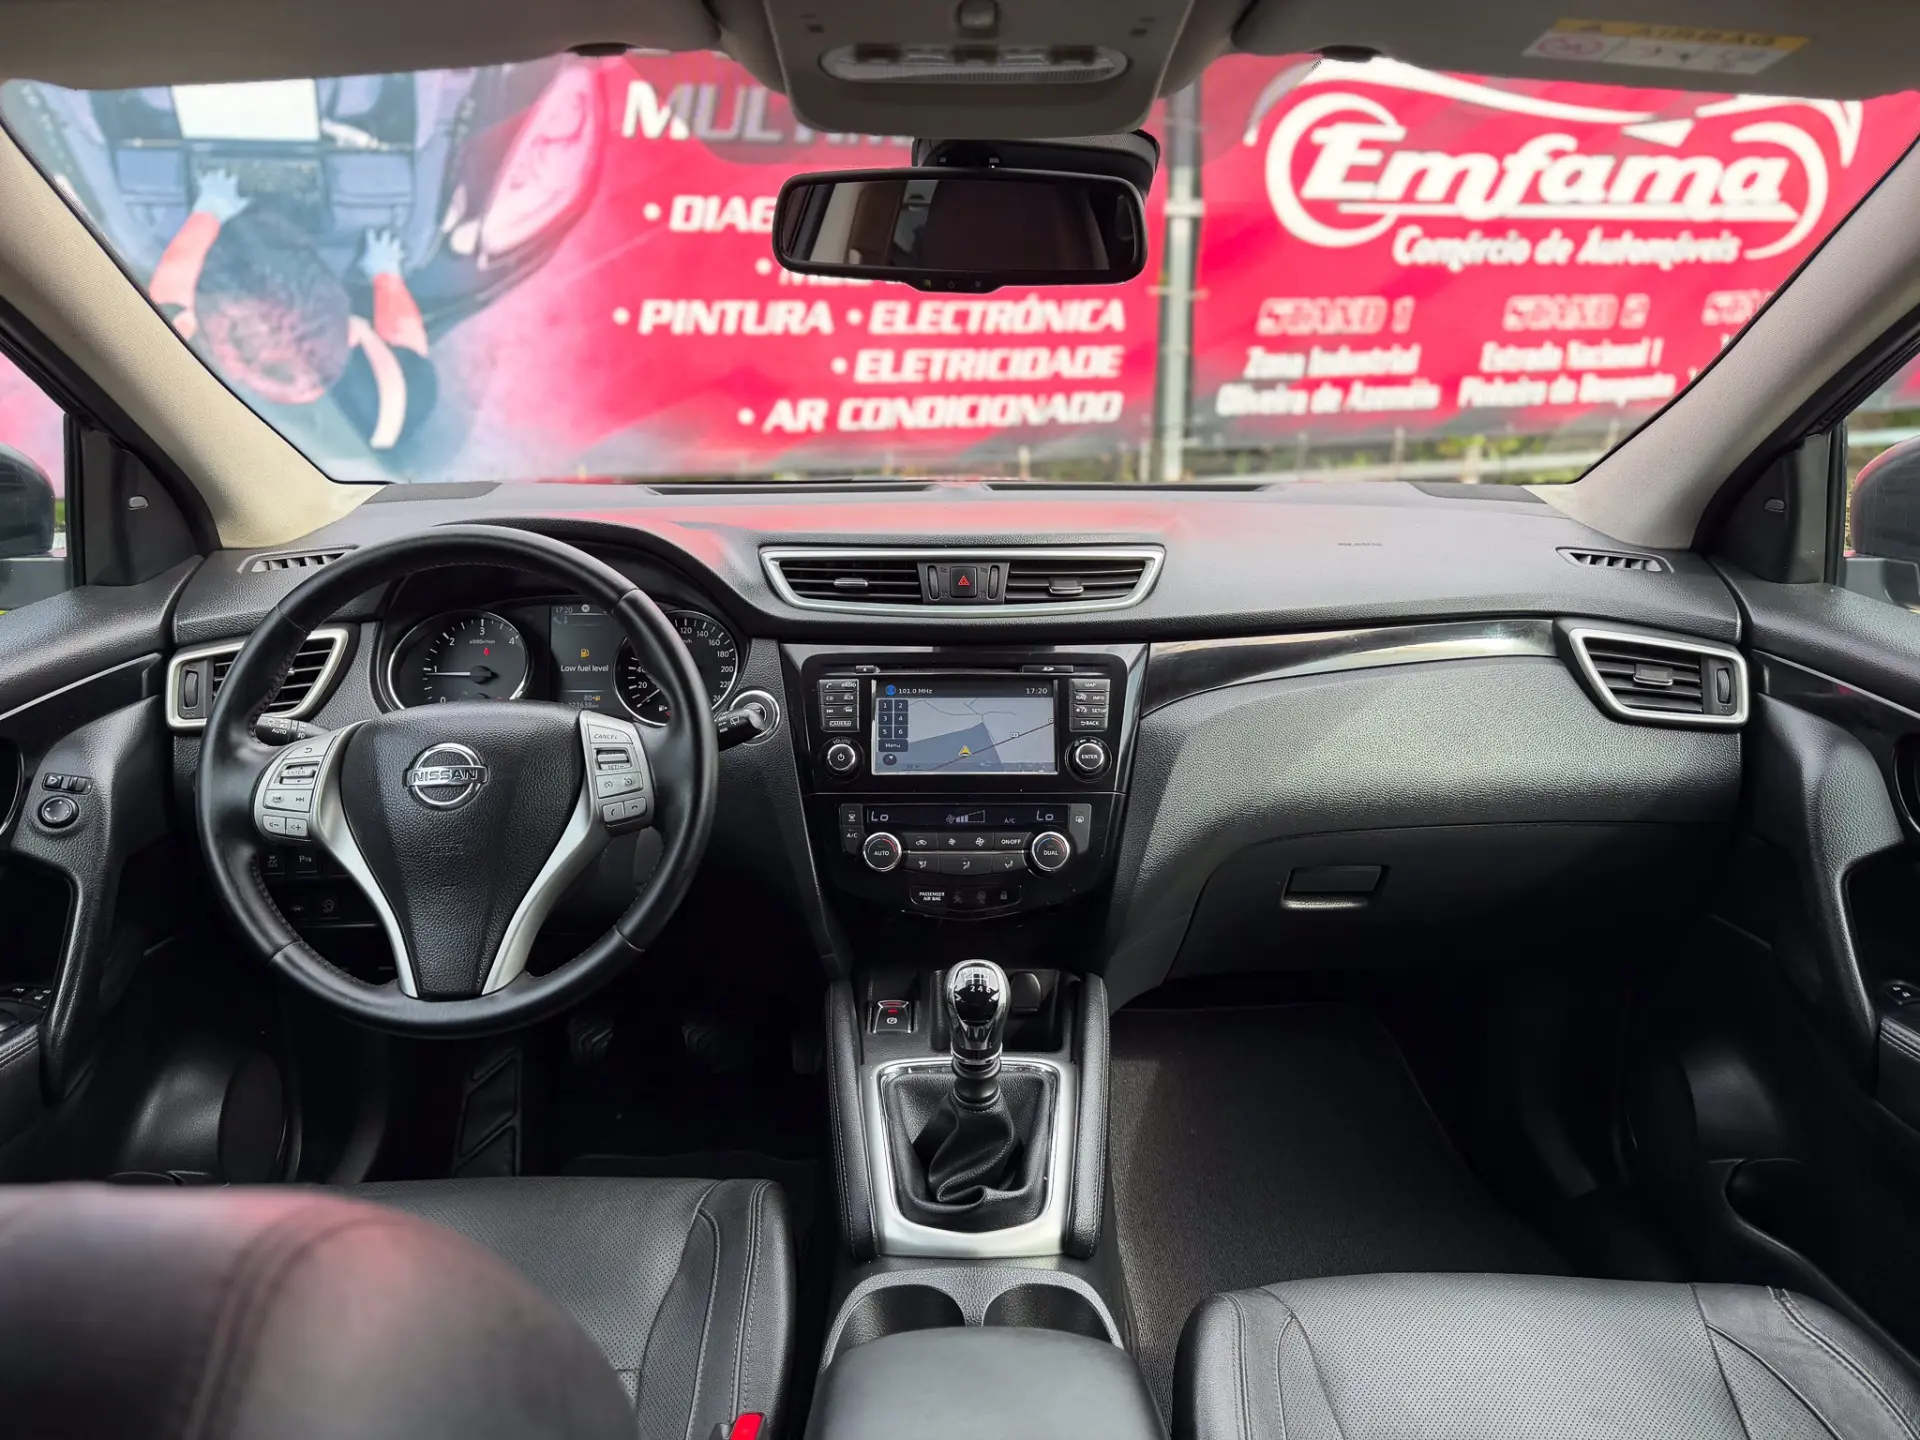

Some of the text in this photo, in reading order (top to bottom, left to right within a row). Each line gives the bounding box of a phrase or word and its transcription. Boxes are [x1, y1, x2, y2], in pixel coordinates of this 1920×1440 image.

[1301, 124, 1785, 221] Emfama
[669, 195, 776, 233] DIAG
[1534, 228, 1574, 265] de
[637, 294, 1126, 335] PINTURA ELECTRÓNICA
[853, 346, 1124, 383] ELETRICIDADE
[762, 392, 1124, 432] AR CONDICIONADO
[480, 627, 485, 635] 3
[696, 630, 708, 638] 140
[449, 638, 455, 646] 2
[577, 664, 591, 672] fuel
[592, 664, 609, 672] level
[720, 665, 734, 673] 200
[637, 681, 647, 689] 20
[411, 768, 478, 783] NISSAN
[871, 810, 889, 821] Lo
[1036, 810, 1054, 821] Lo
